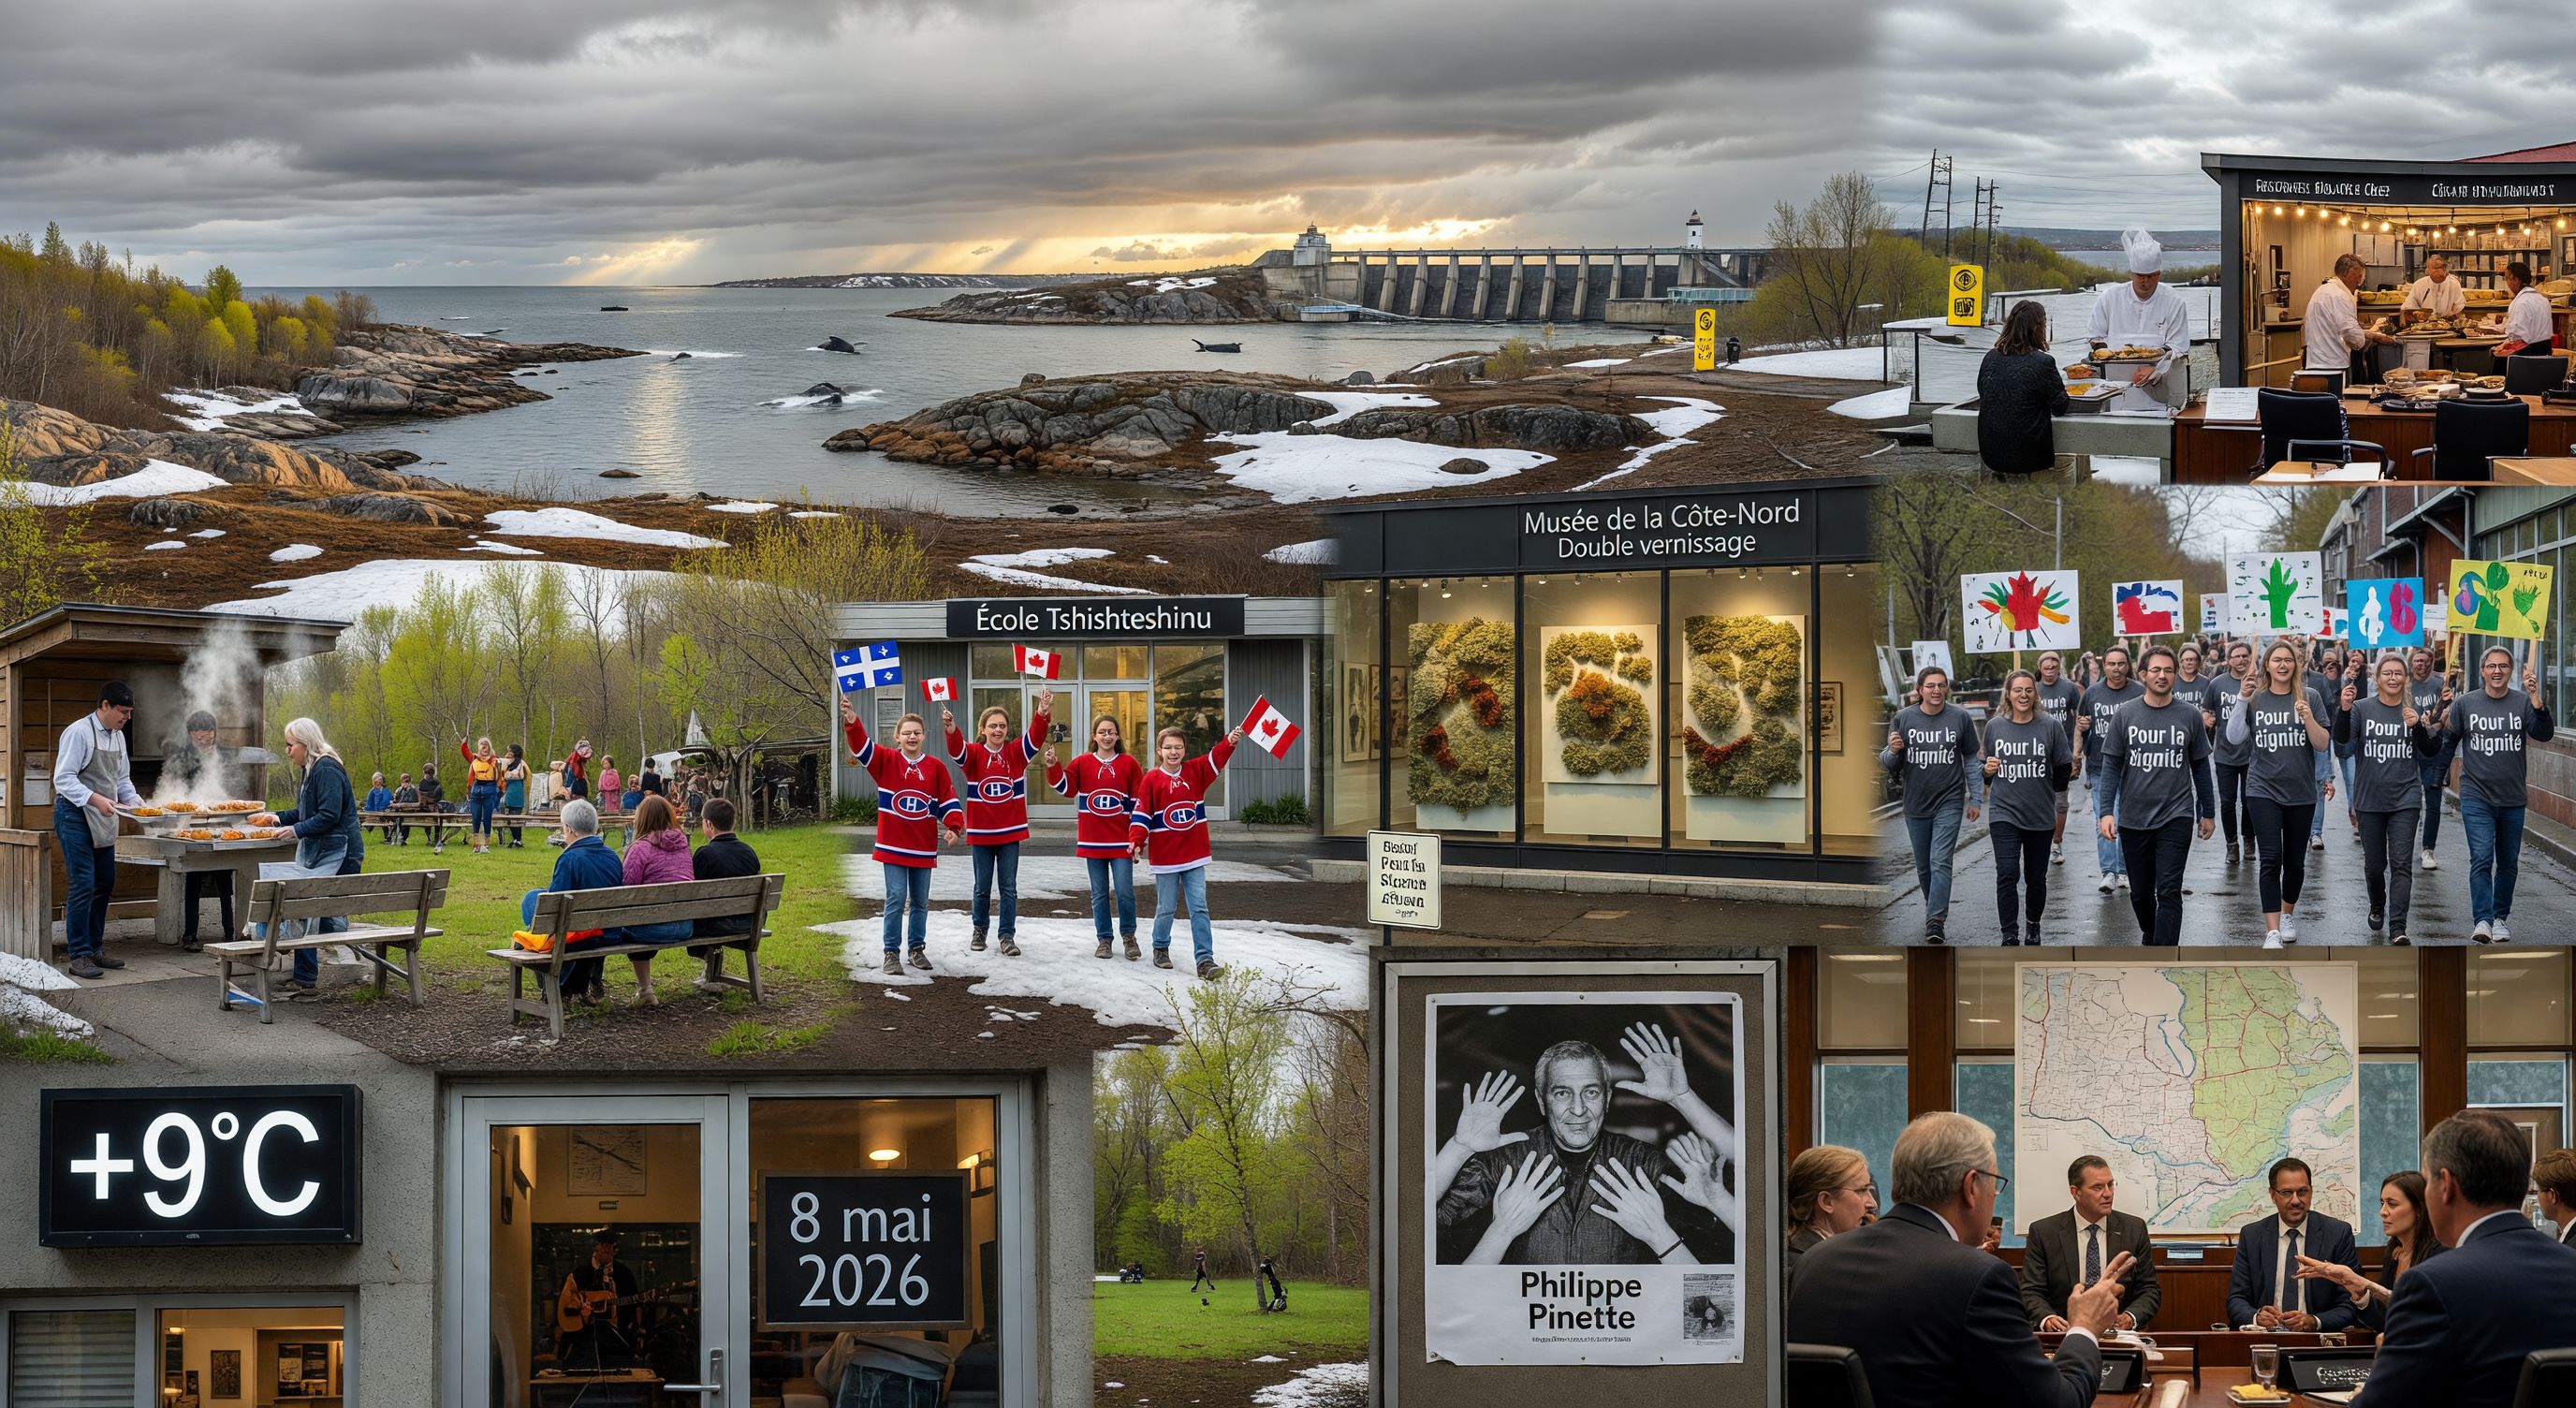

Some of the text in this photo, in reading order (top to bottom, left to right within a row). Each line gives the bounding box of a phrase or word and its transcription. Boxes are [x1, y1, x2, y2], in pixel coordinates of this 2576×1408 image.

[1525, 498, 1799, 534] Musée de la Côte-Nord
[1559, 532, 1756, 559] Double vernissage
[976, 603, 1211, 631] École Tshishteshinu
[2255, 710, 2290, 726] Pour
[2365, 719, 2401, 737] Pour
[2469, 711, 2523, 731] Pour la
[1908, 726, 1957, 745] Pour la
[1995, 739, 2028, 758] Pour
[2128, 726, 2167, 745] Pour
[2171, 725, 2185, 746] la
[2255, 726, 2306, 753] dignité
[2364, 739, 2413, 764] dignité
[70, 1110, 321, 1218] +9°C
[790, 1192, 930, 1243] 8 mai
[798, 1253, 929, 1307] 2026
[1521, 1270, 1642, 1307] Philippe
[1529, 1303, 1636, 1330] Pinette
